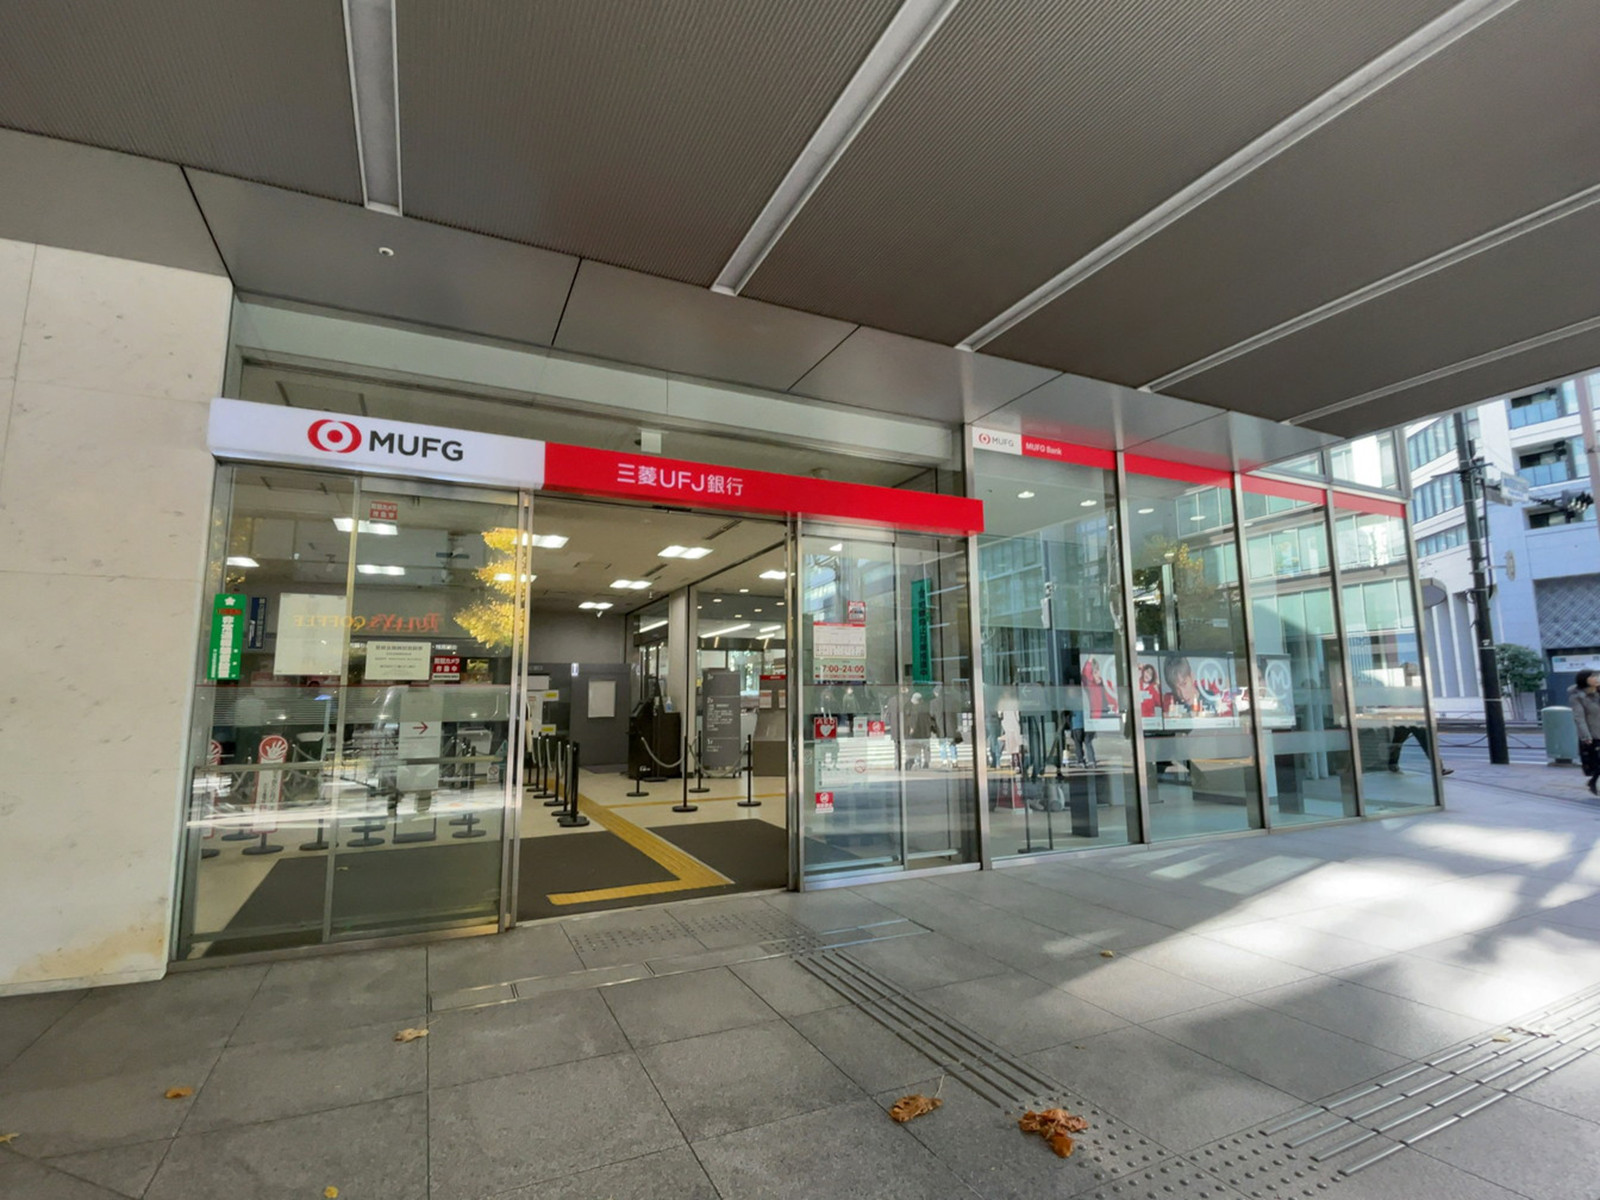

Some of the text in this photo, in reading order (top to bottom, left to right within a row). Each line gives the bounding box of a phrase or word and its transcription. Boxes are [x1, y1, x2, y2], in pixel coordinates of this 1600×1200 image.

[369, 430, 464, 462] MUFG
[992, 437, 1014, 447] MUFG
[1026, 443, 1062, 455] MUFG Bank
[616, 463, 744, 497] 三菱UFJ銀行
